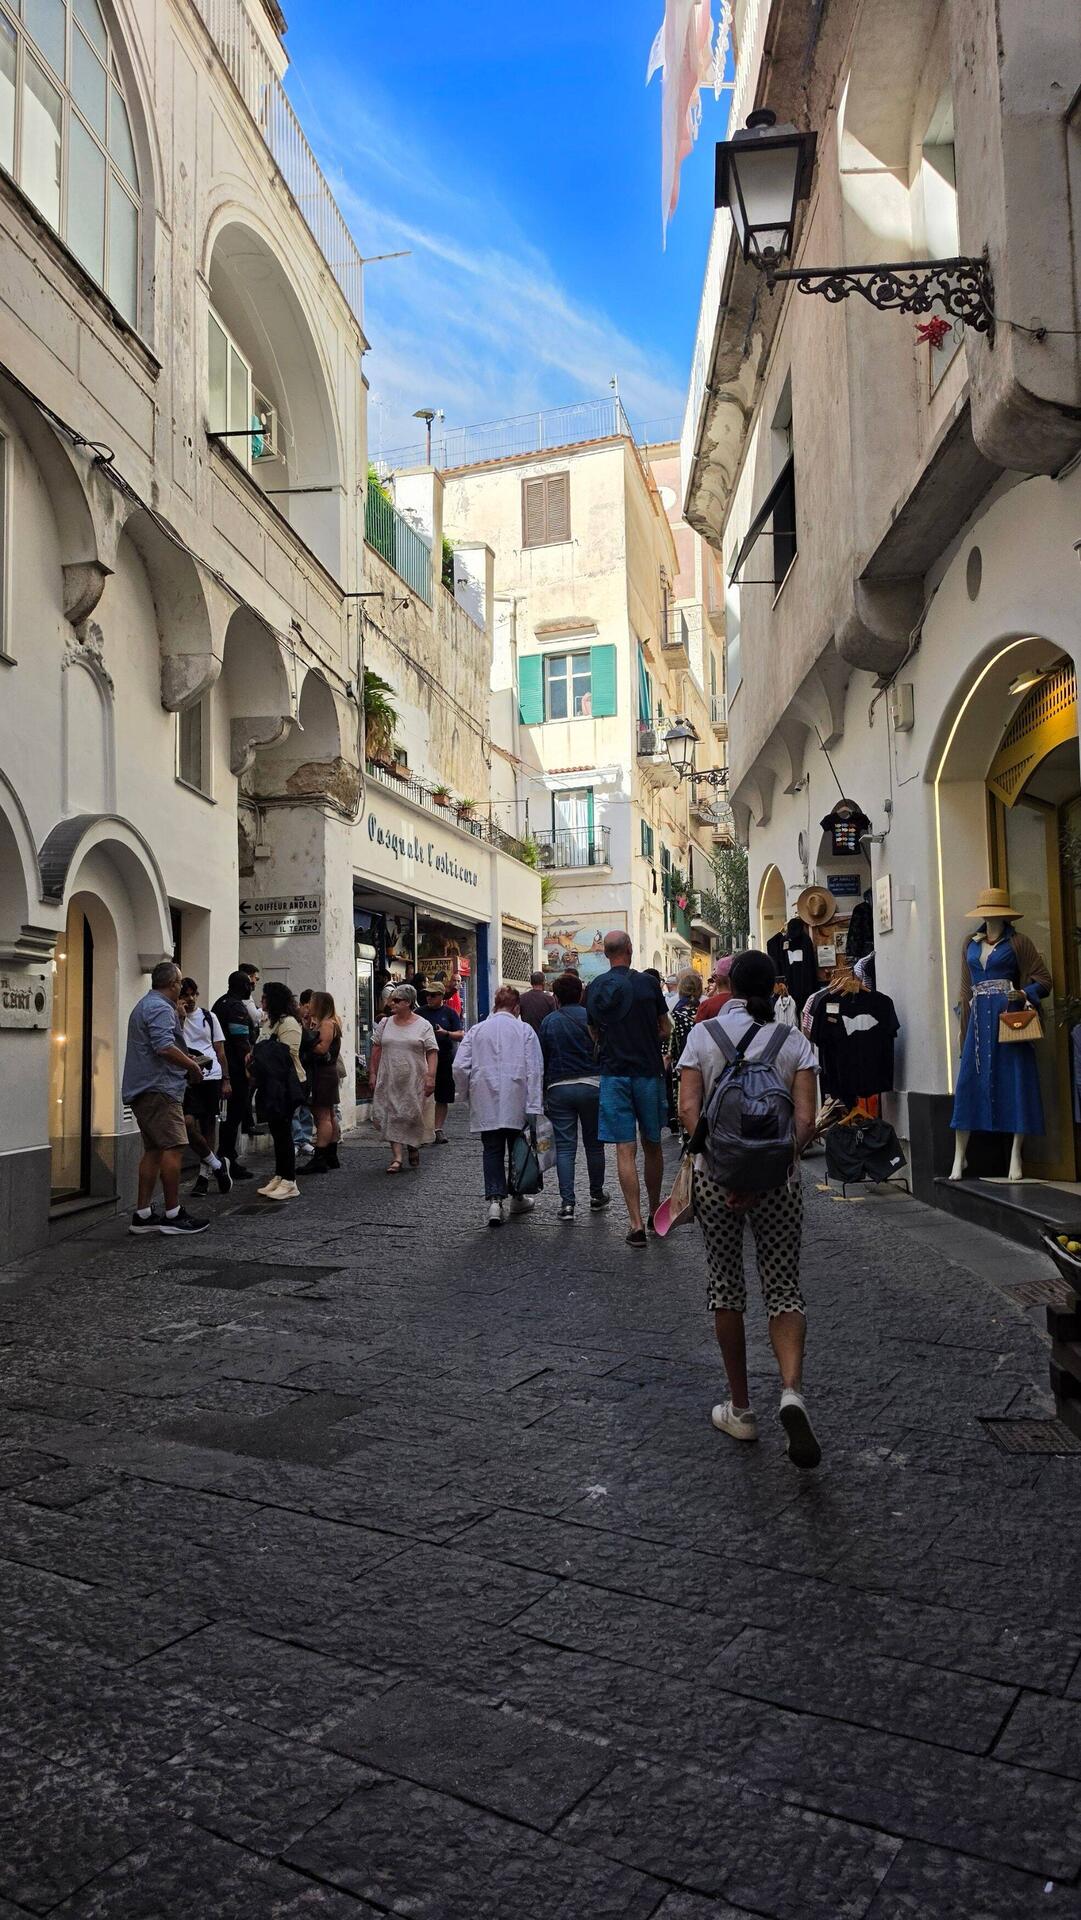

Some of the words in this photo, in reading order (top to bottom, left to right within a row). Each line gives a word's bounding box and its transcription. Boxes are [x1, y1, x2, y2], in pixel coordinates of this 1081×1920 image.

[367, 812, 424, 863] Pasquale
[254, 902, 287, 911] COIFFEUR
[289, 901, 317, 909] ANDREA
[289, 924, 318, 932] TEATRO
